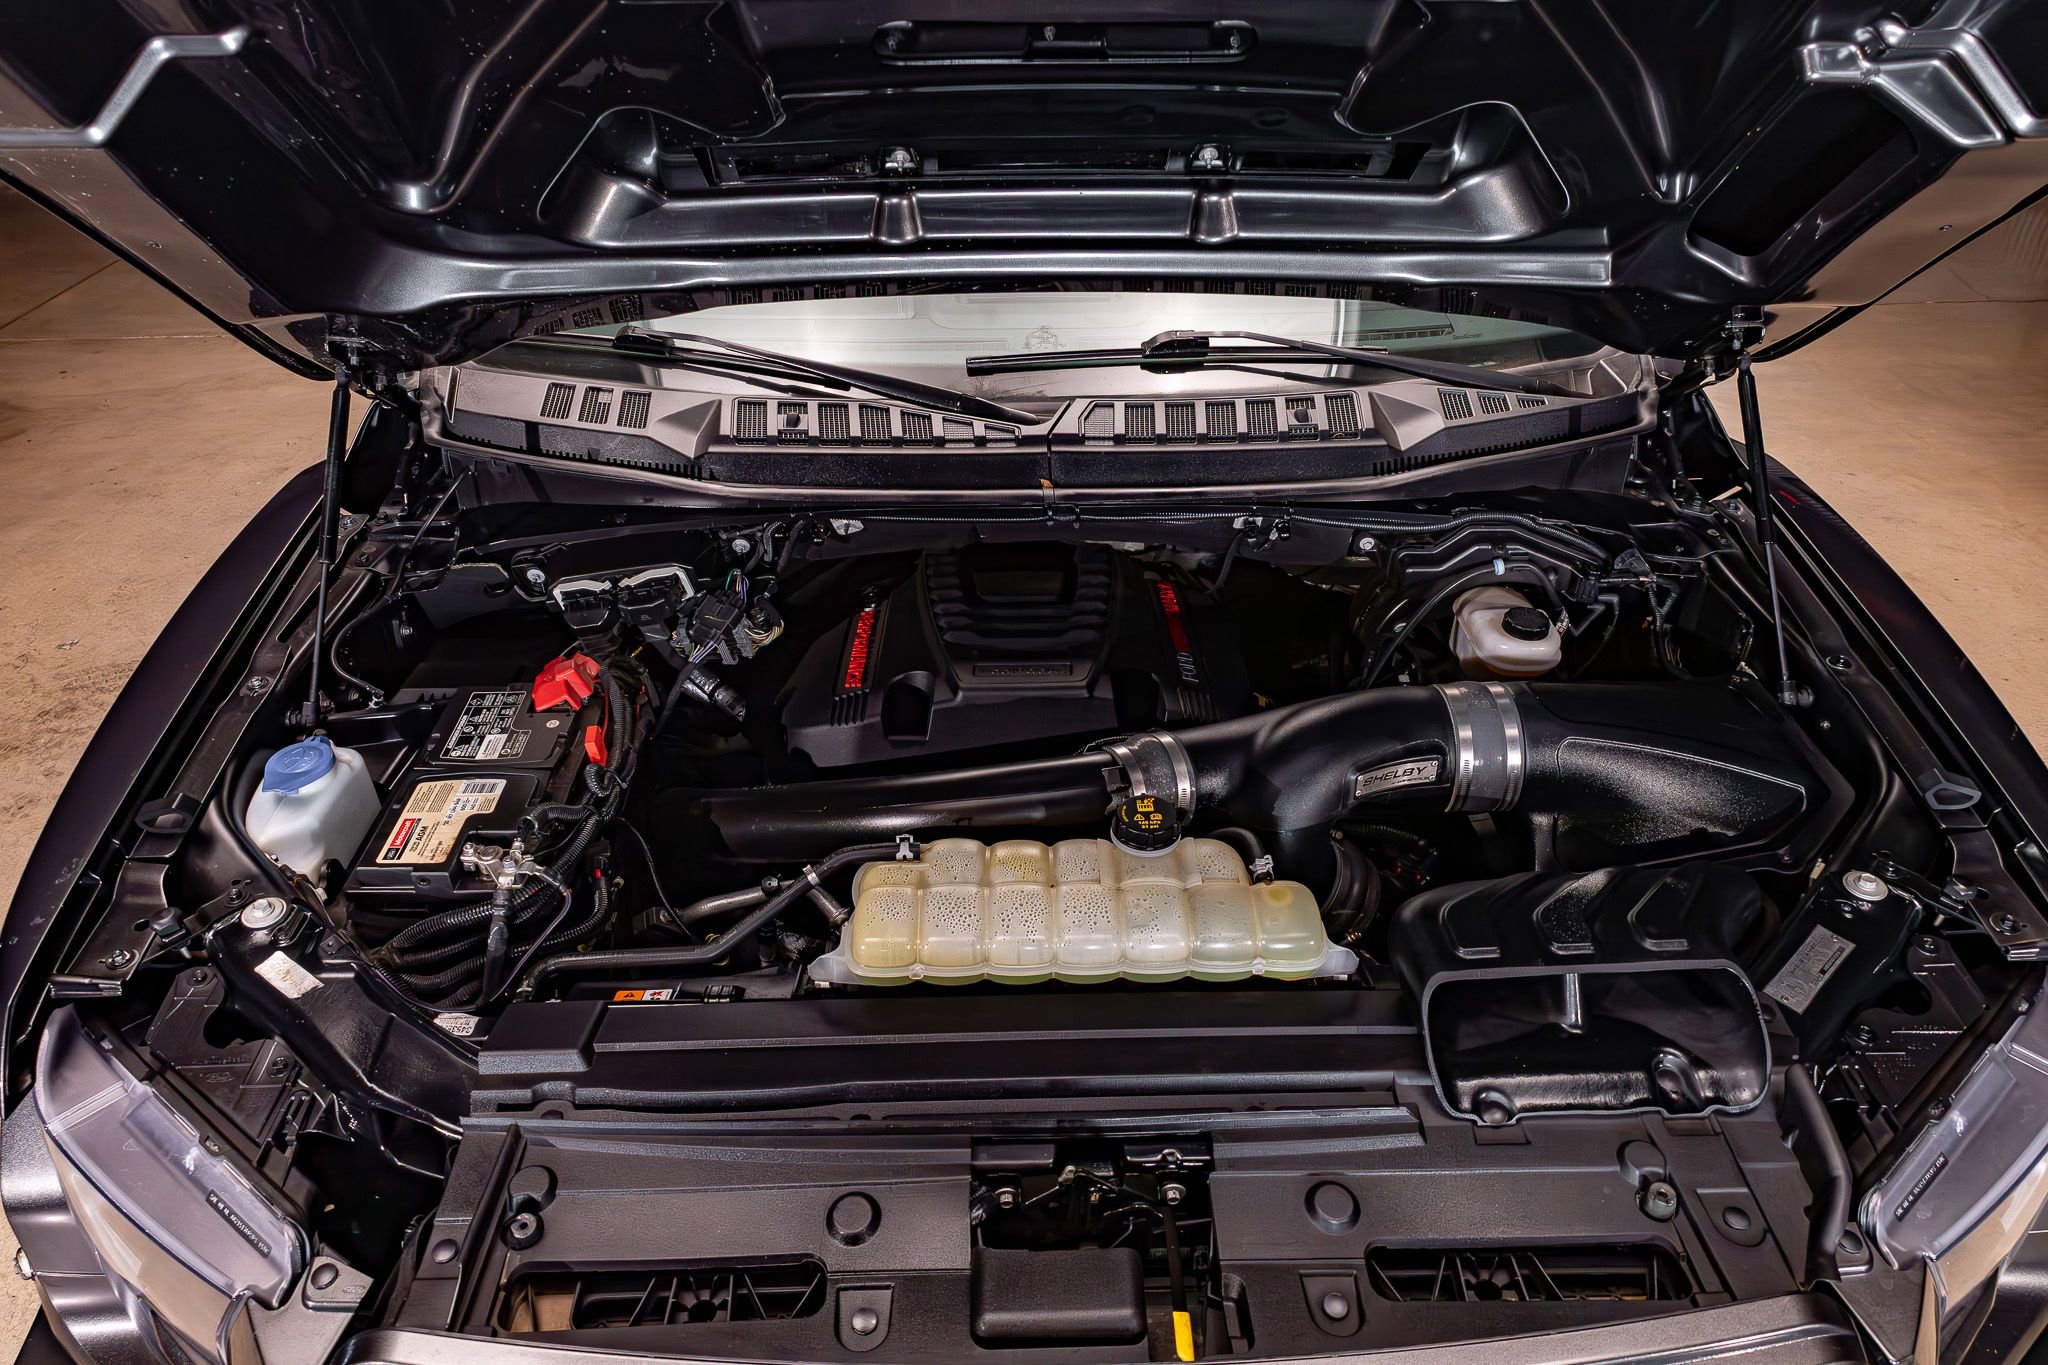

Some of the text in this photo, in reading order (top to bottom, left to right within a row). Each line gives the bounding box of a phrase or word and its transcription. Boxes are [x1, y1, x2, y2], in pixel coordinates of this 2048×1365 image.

[1362, 765, 1428, 787] SHELBY
[394, 818, 413, 846] Motorcraft
[416, 825, 429, 841] AGM
